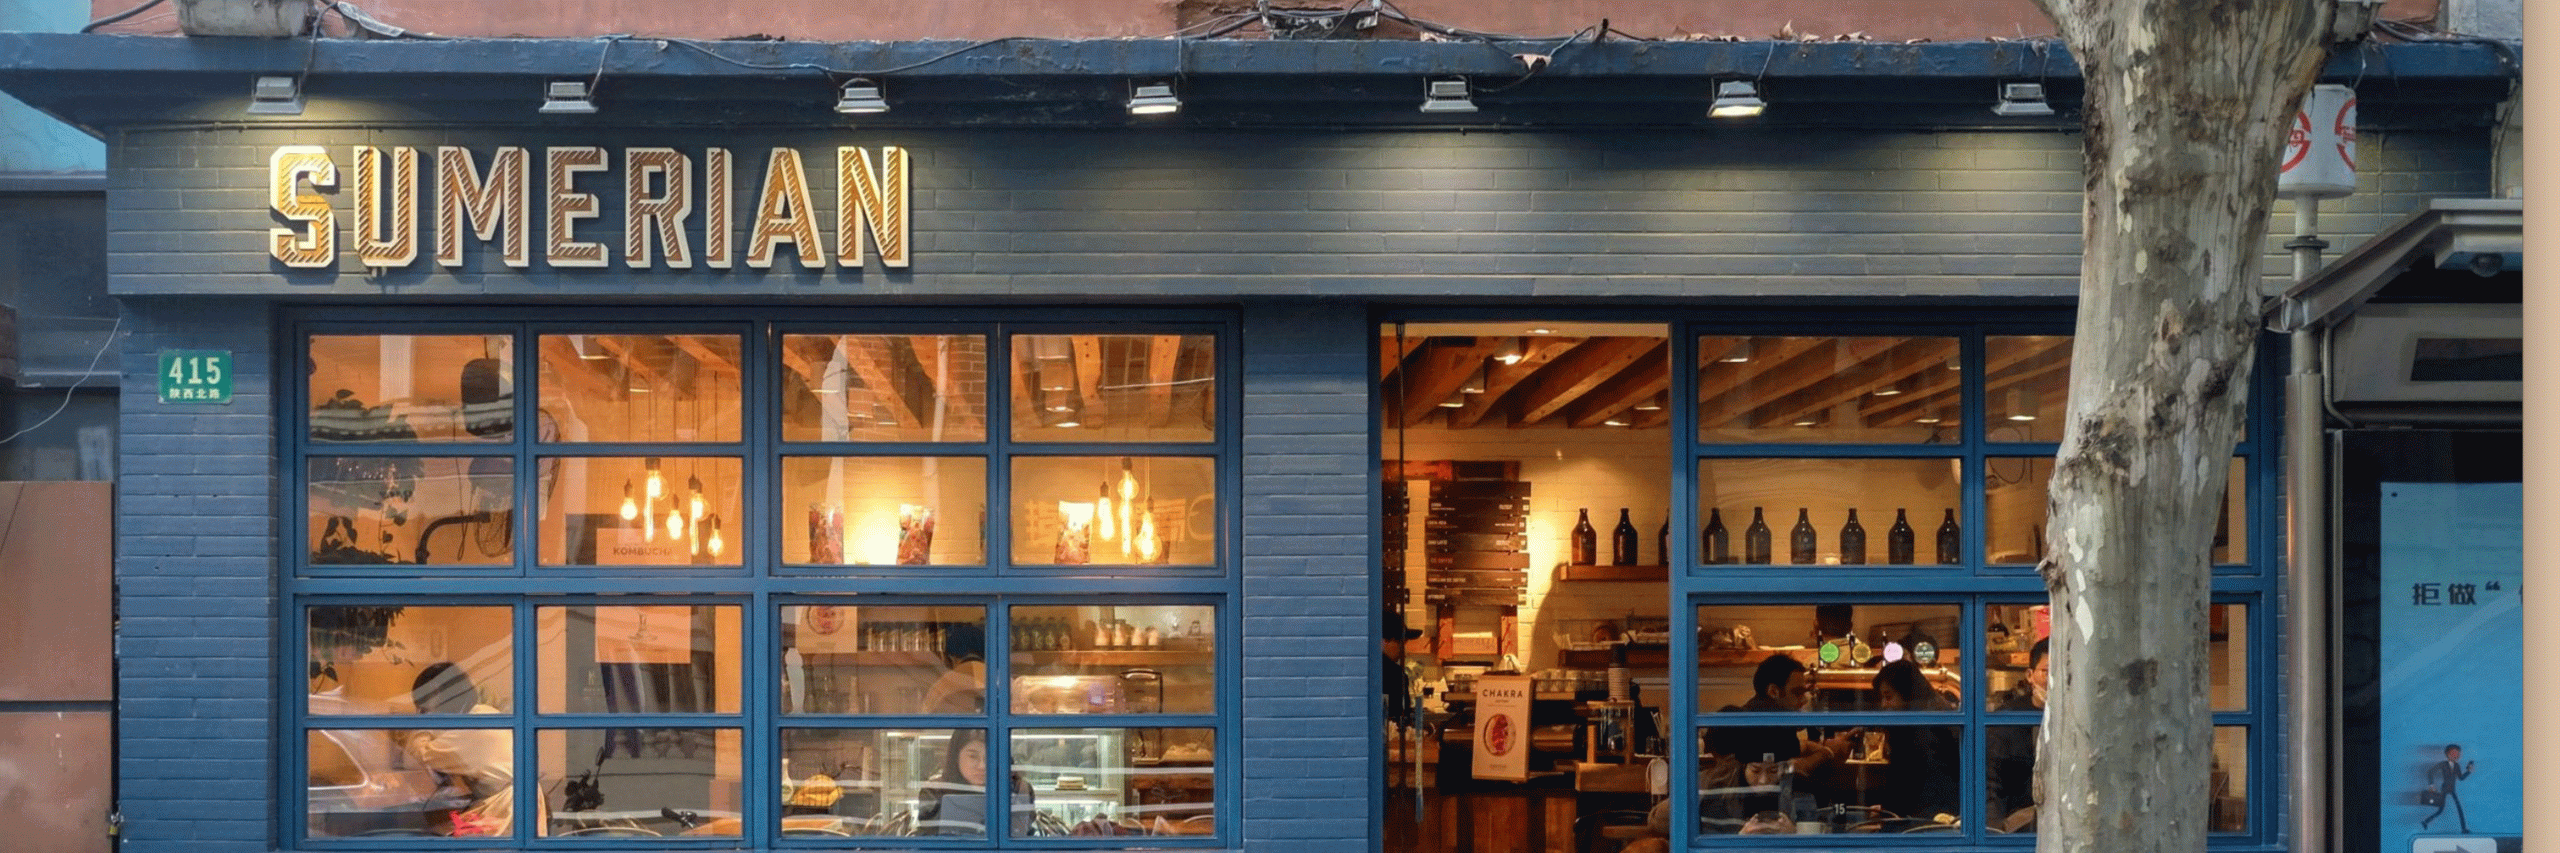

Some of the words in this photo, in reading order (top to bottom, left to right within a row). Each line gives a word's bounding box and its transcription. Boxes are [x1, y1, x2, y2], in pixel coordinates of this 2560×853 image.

[269, 145, 911, 269] SUMERIAN
[168, 357, 221, 385] 415
[2412, 581, 2523, 606] 拒做“
[1482, 688, 1523, 698] CHAKRA
[1834, 803, 1846, 815] 15
